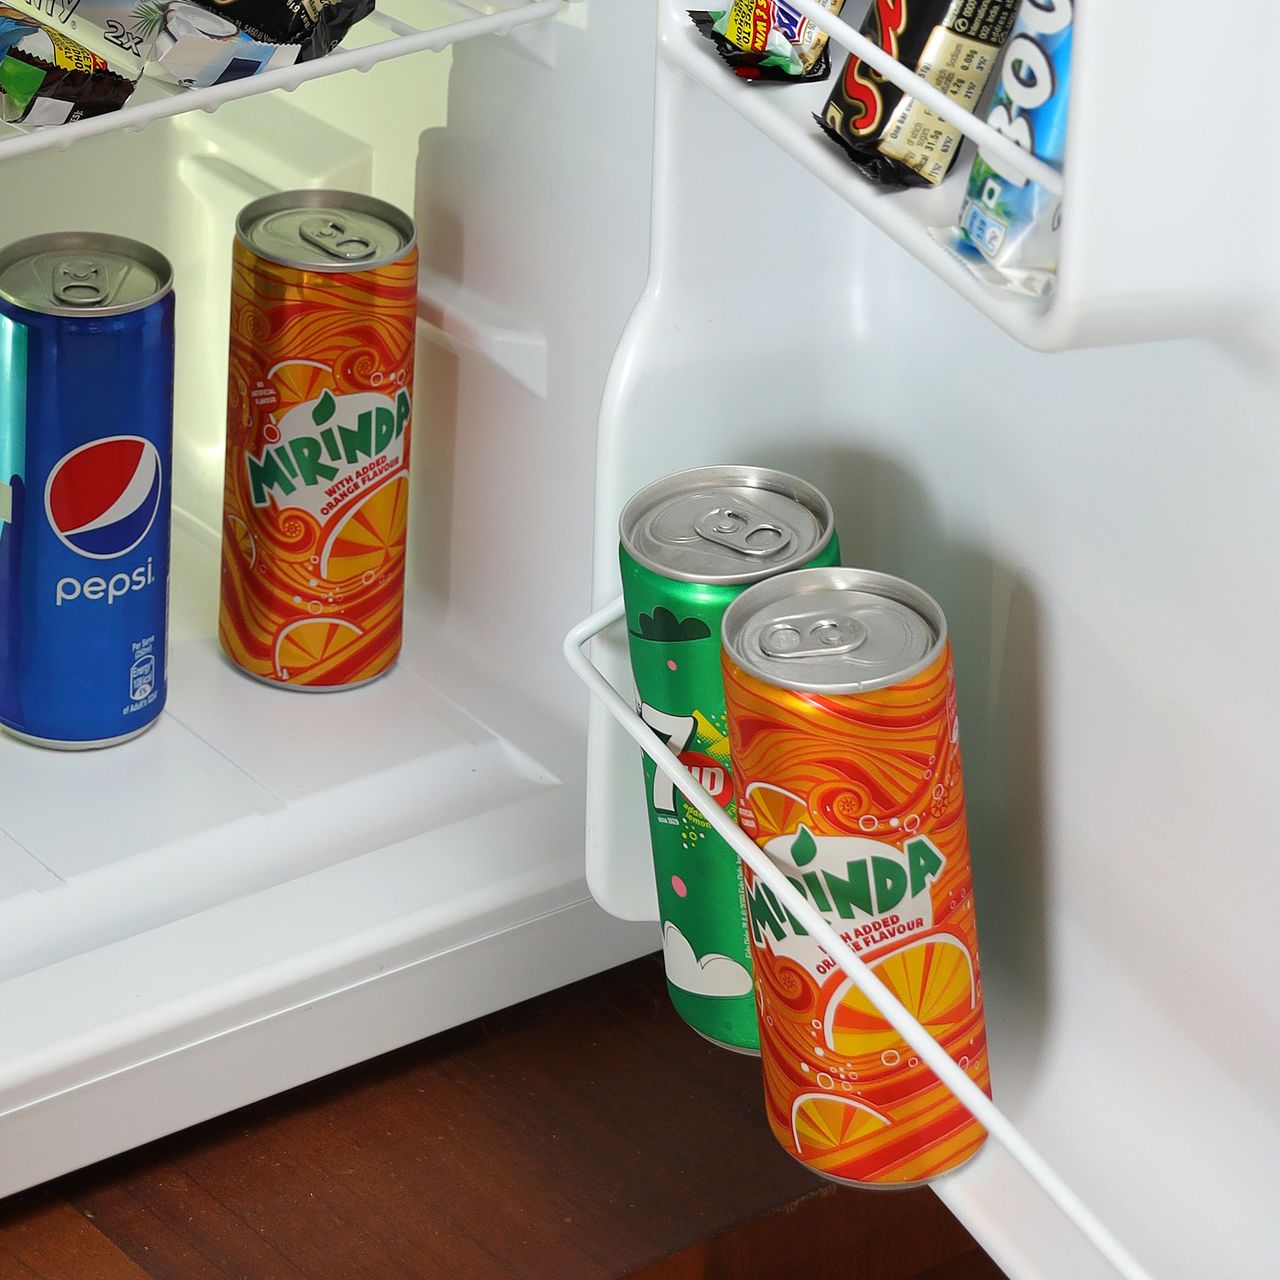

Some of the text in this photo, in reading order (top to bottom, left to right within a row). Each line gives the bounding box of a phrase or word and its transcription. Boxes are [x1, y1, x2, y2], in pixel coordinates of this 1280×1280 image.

[104, 19, 144, 57] 2x
[755, 22, 765, 50] WIN
[949, 77, 964, 97] 4.2g
[247, 390, 410, 504] MIRINDA
[320, 456, 400, 516] ORANGE FLAVOUR
[325, 455, 387, 497] WITH ADDED
[56, 555, 153, 606] pepsi
[641, 702, 698, 814] 7
[852, 914, 900, 937] ADDED
[864, 917, 925, 947] FLAVOUR
